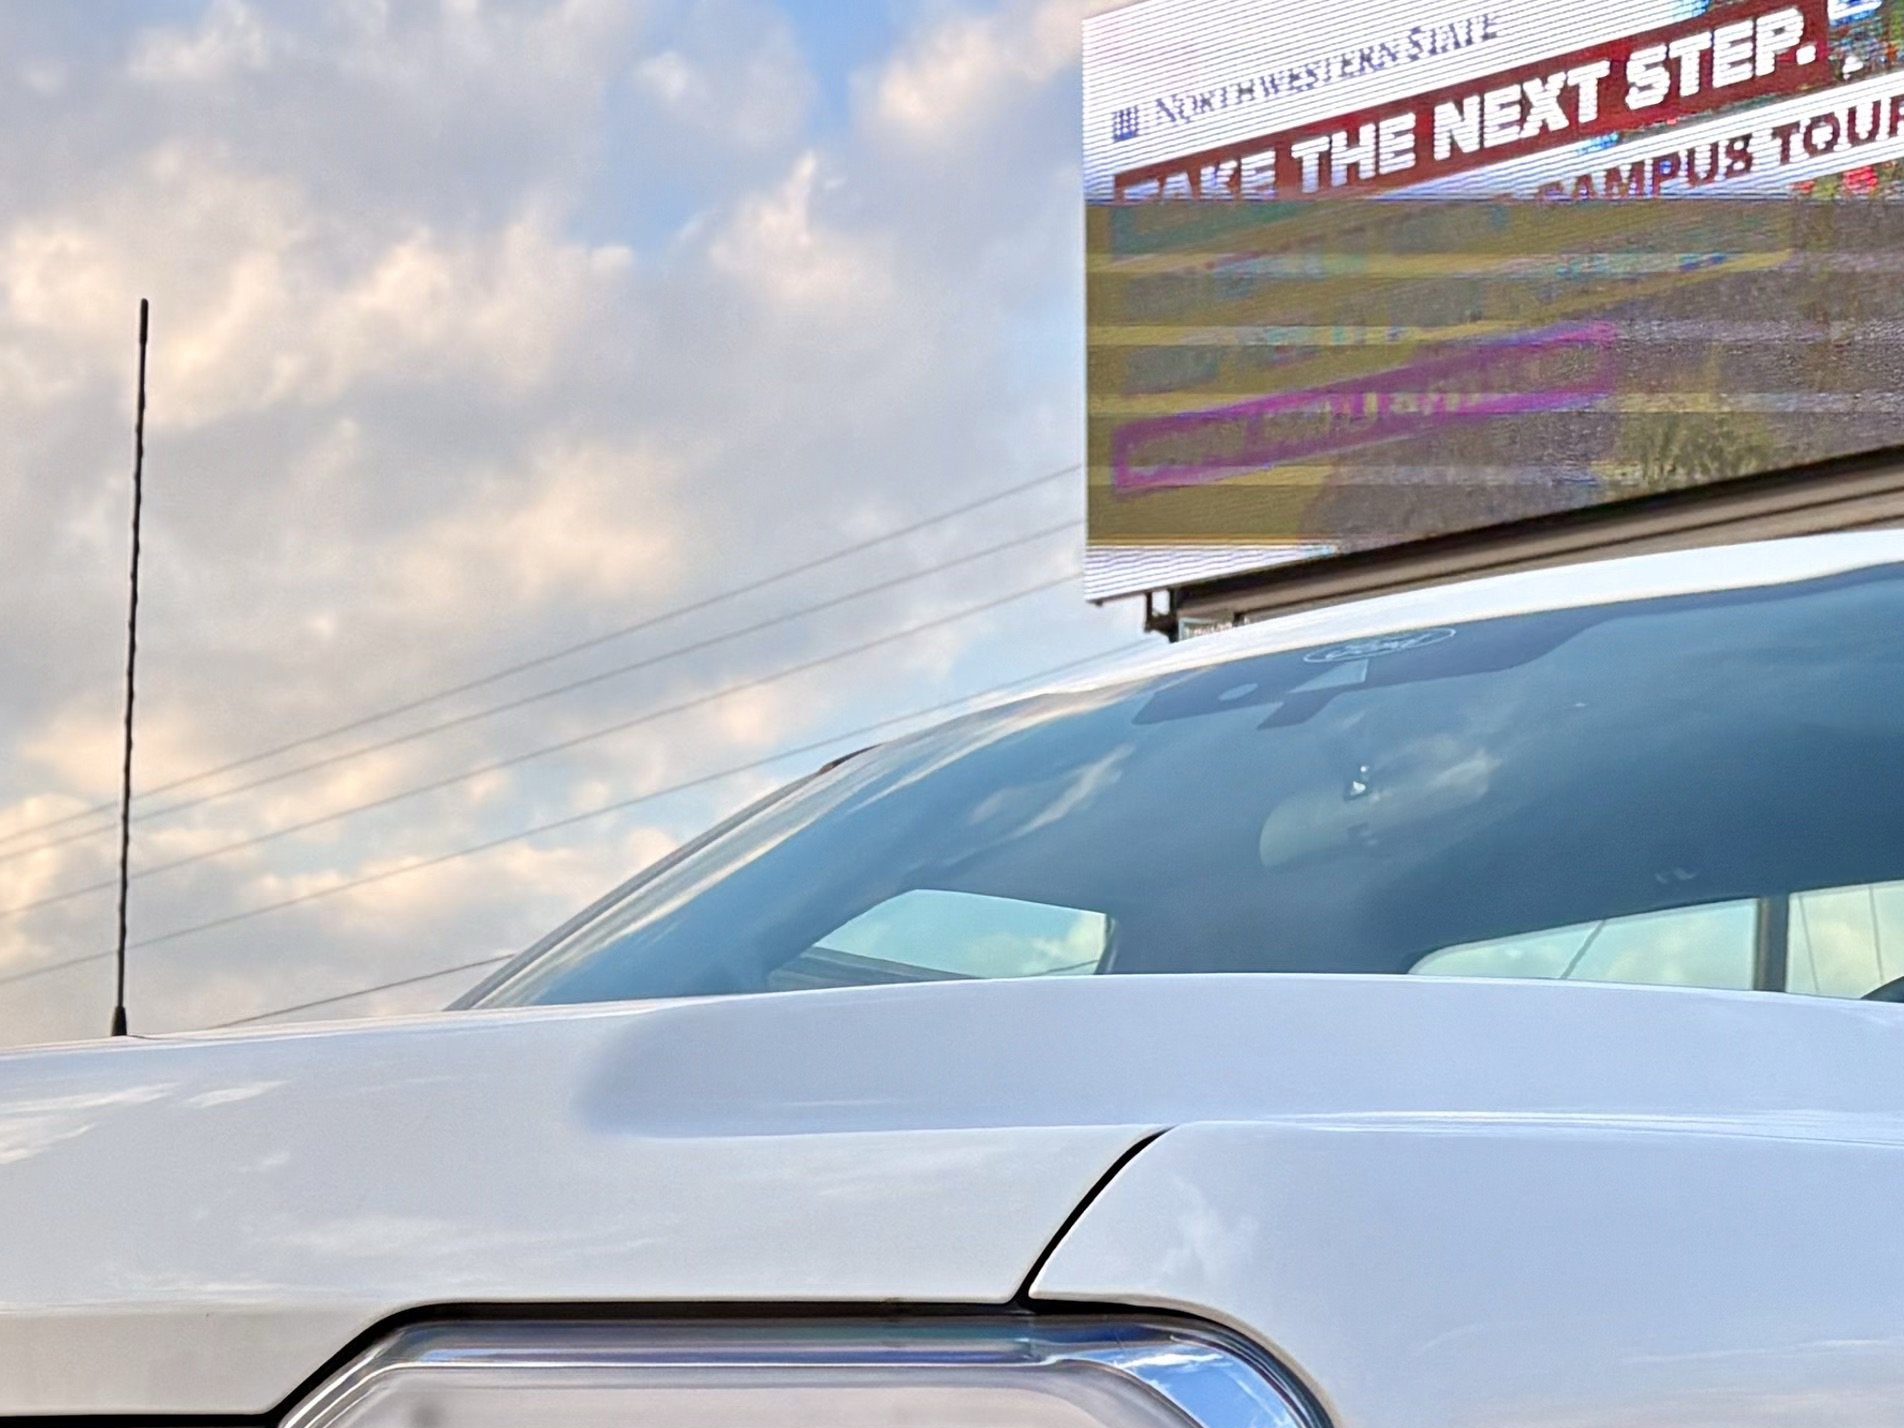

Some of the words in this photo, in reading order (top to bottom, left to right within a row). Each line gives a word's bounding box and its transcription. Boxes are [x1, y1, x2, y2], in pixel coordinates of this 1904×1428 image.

[1292, 112, 1416, 193] THE
[1433, 61, 1610, 160] NEXT
[1625, 9, 1816, 110] STEP.
